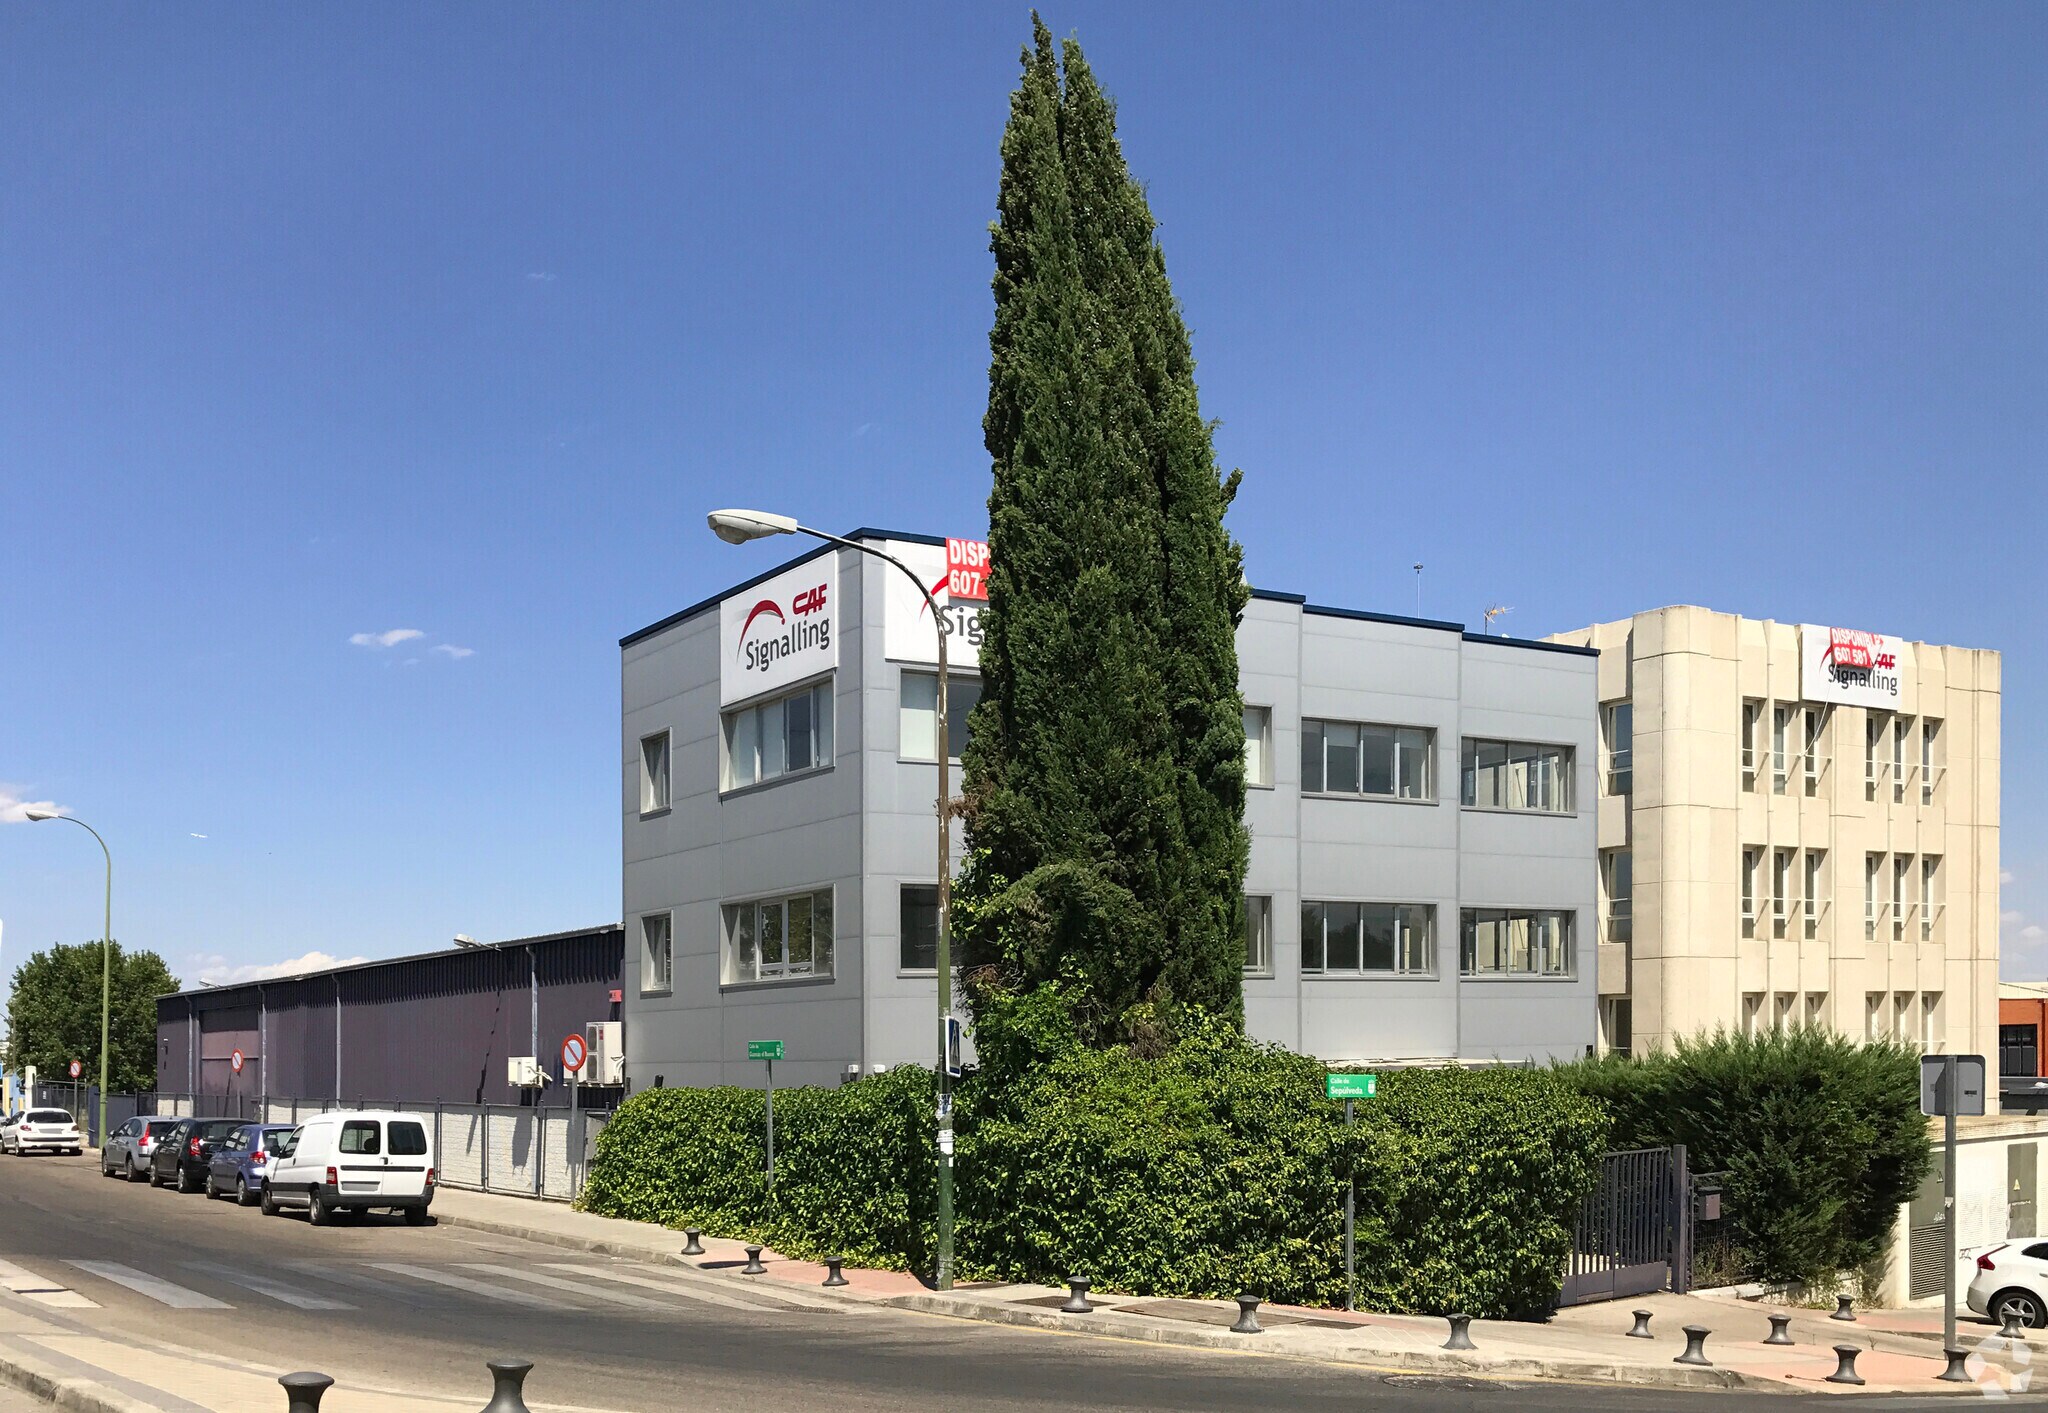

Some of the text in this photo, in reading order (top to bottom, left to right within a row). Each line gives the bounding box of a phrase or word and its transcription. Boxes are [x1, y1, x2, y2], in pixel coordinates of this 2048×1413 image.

[949, 539, 991, 567] DISP
[949, 569, 981, 596] 607
[792, 583, 827, 616] CAF
[746, 617, 830, 672] Signalling
[1834, 646, 1868, 665] 607 581
[1828, 664, 1898, 696] Signalling
